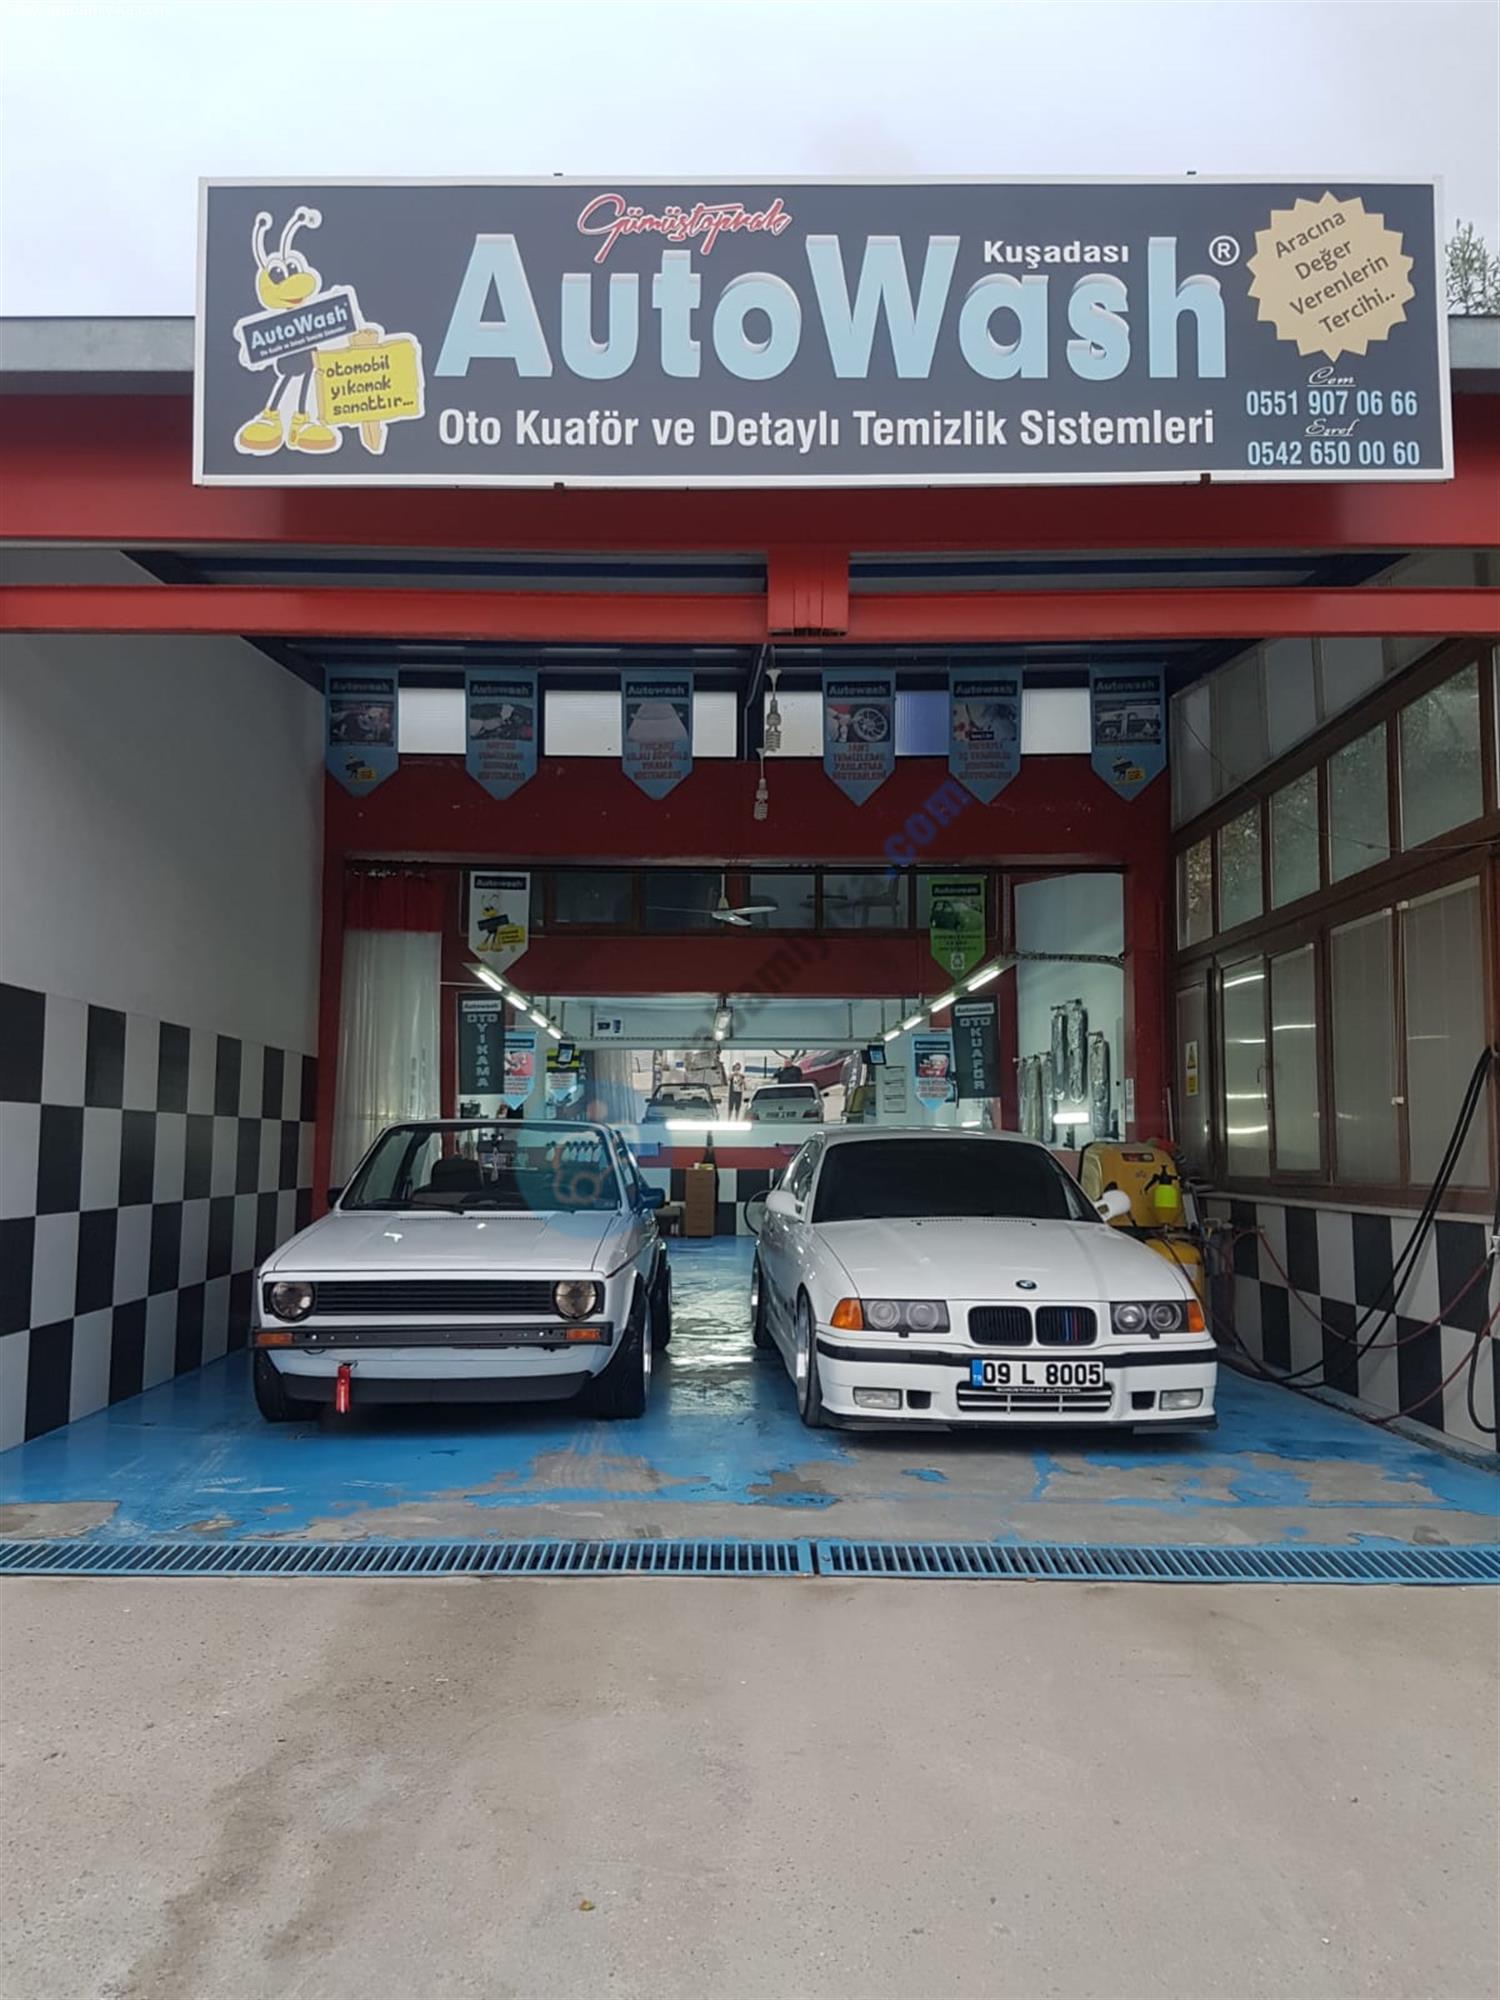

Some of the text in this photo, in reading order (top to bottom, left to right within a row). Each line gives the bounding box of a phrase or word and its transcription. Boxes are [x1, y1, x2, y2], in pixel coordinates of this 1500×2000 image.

[1274, 210, 1346, 258] Aracına
[984, 240, 1129, 269] Kuşadası
[1295, 240, 1353, 280] Değer
[1290, 253, 1389, 316] Verenlerin
[434, 233, 1226, 380] AutoWash
[1319, 290, 1397, 337] Tercihi..
[251, 305, 347, 350] AutoWash
[326, 355, 390, 378] otomobil
[1308, 366, 1355, 385] Cem
[331, 375, 391, 400] yıkamak
[333, 394, 414, 416] sanattır...
[1246, 390, 1418, 416] 0551 907 06 66
[439, 408, 1215, 454] Oto Kuaför ve Detaylı Temizlik Sistemleri
[1248, 441, 1420, 466] 0542 650 00 60
[467, 1014, 498, 1023] OTO
[960, 1018, 991, 1027] OTO
[475, 1023, 490, 1087] YIKAMA
[983, 1363, 1010, 1384] 09
[1022, 1363, 1035, 1384] L
[1046, 1364, 1101, 1386] 8005
